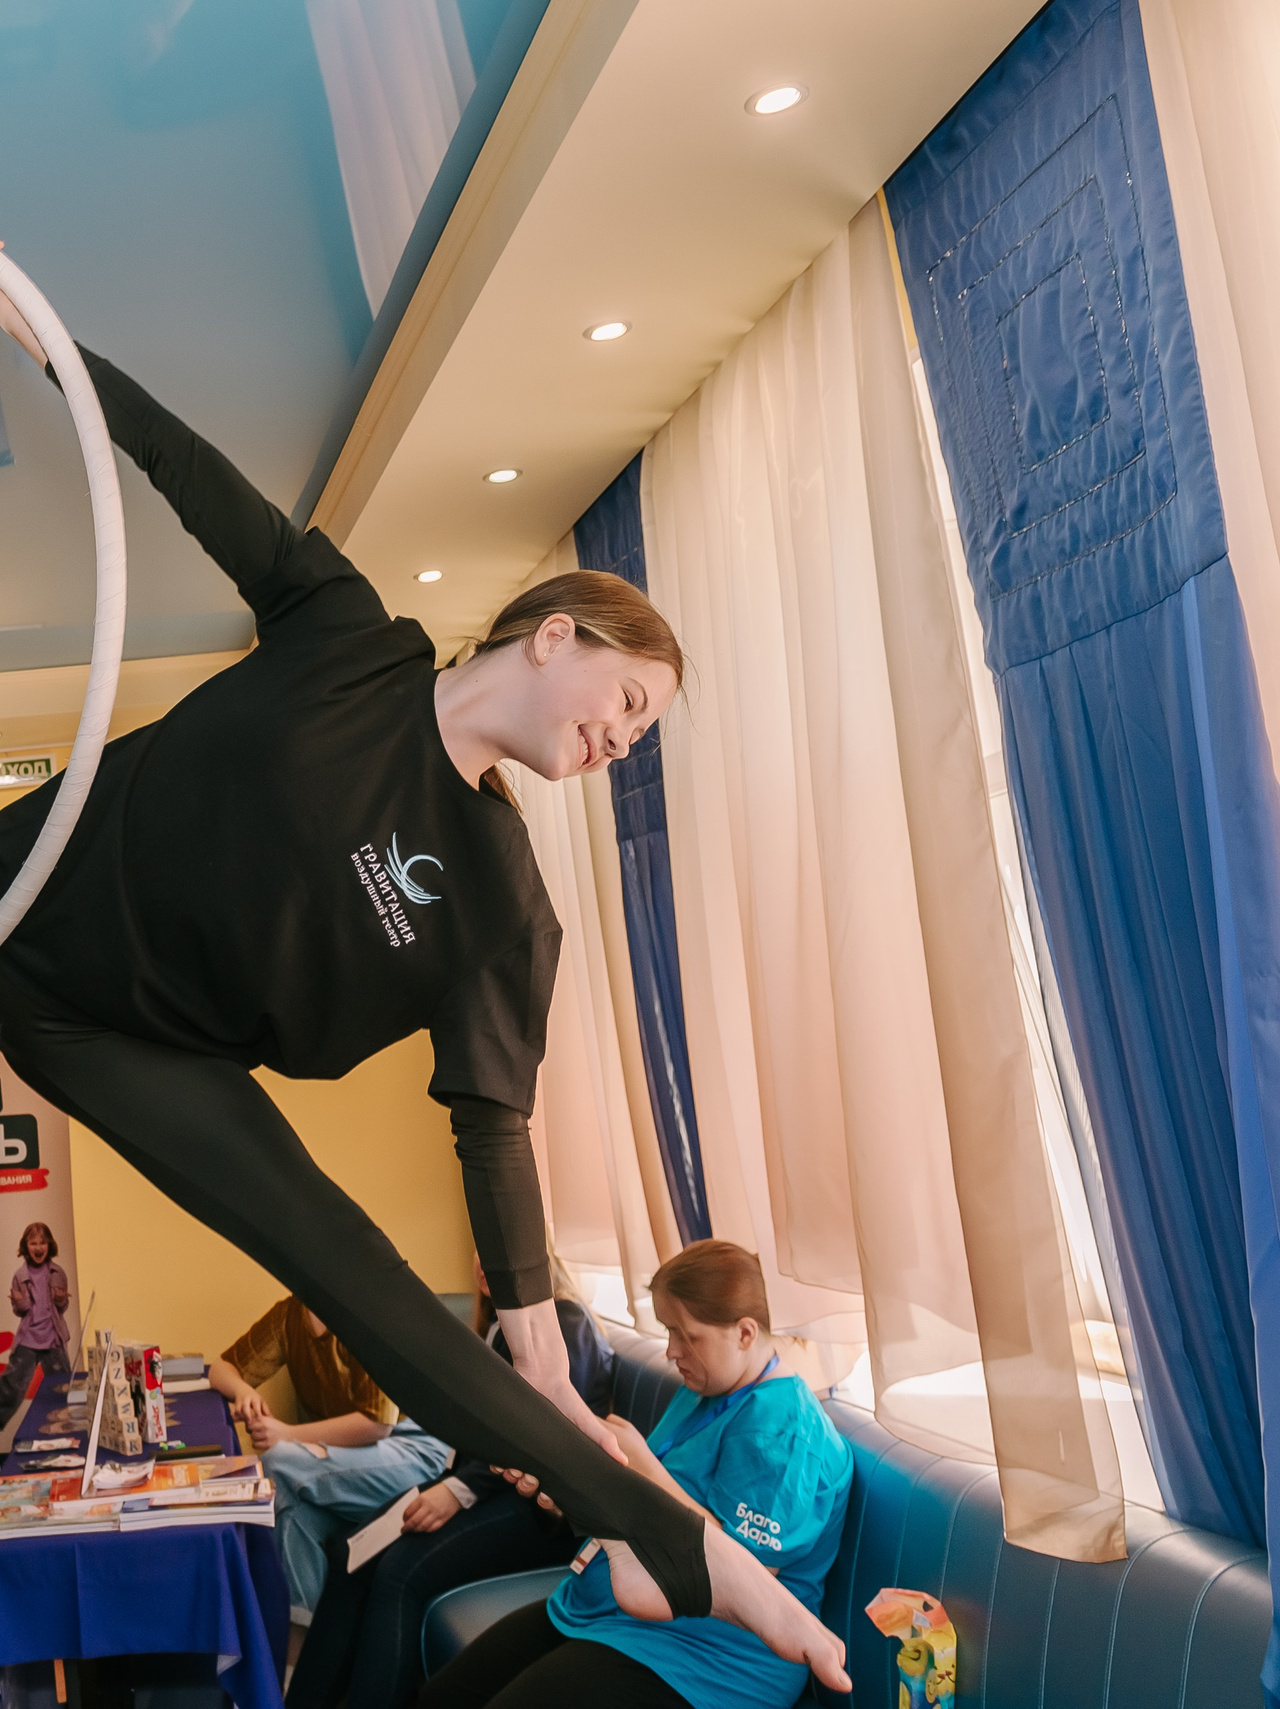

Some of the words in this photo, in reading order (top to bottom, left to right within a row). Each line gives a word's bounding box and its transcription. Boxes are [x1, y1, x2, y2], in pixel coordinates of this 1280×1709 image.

[350, 852, 388, 916] воздушный
[381, 916, 401, 948] театр
[359, 843, 416, 945] ГРАВИТАЦИЯ
[736, 1502, 781, 1534] Благо
[736, 1520, 782, 1551] Дарю
